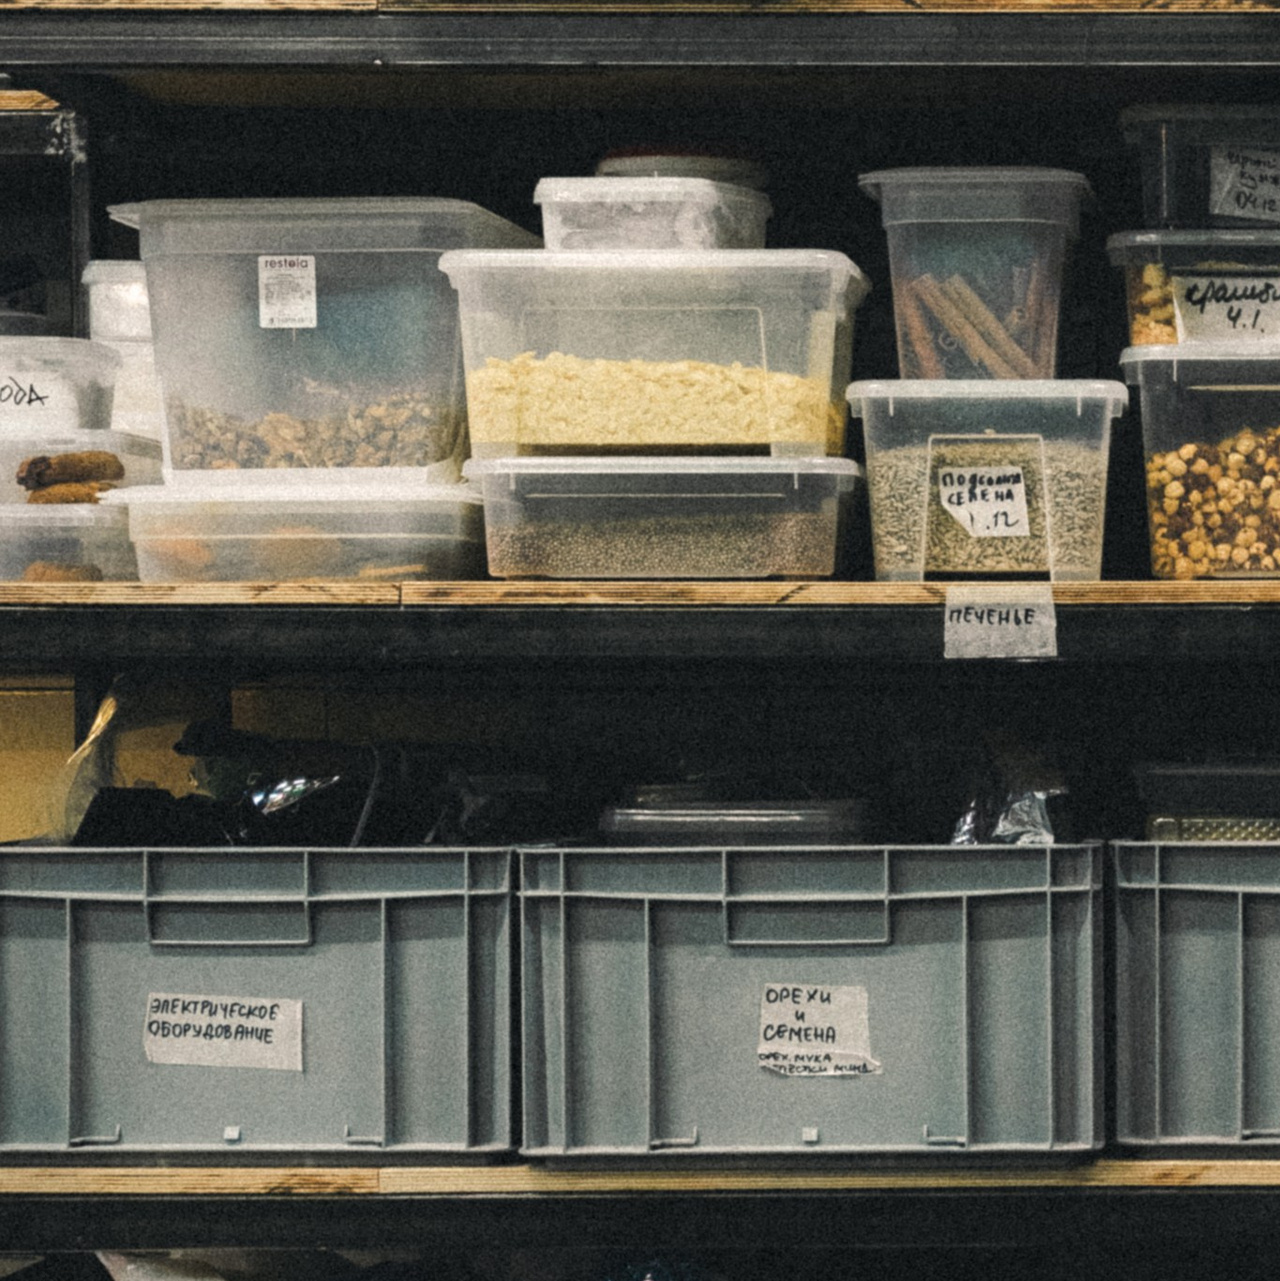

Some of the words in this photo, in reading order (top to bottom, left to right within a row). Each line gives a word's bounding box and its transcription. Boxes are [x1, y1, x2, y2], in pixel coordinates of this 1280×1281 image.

[949, 606, 1036, 626] ПЕЧЕНЬЕ
[765, 986, 832, 1005] ОРЕХИ
[151, 997, 280, 1021] ЭЛЕКТРИЧЕСКОЕ
[147, 1019, 275, 1045] ОБОРУДОВАНИЕ
[763, 1024, 837, 1044] СЕМЕНА
